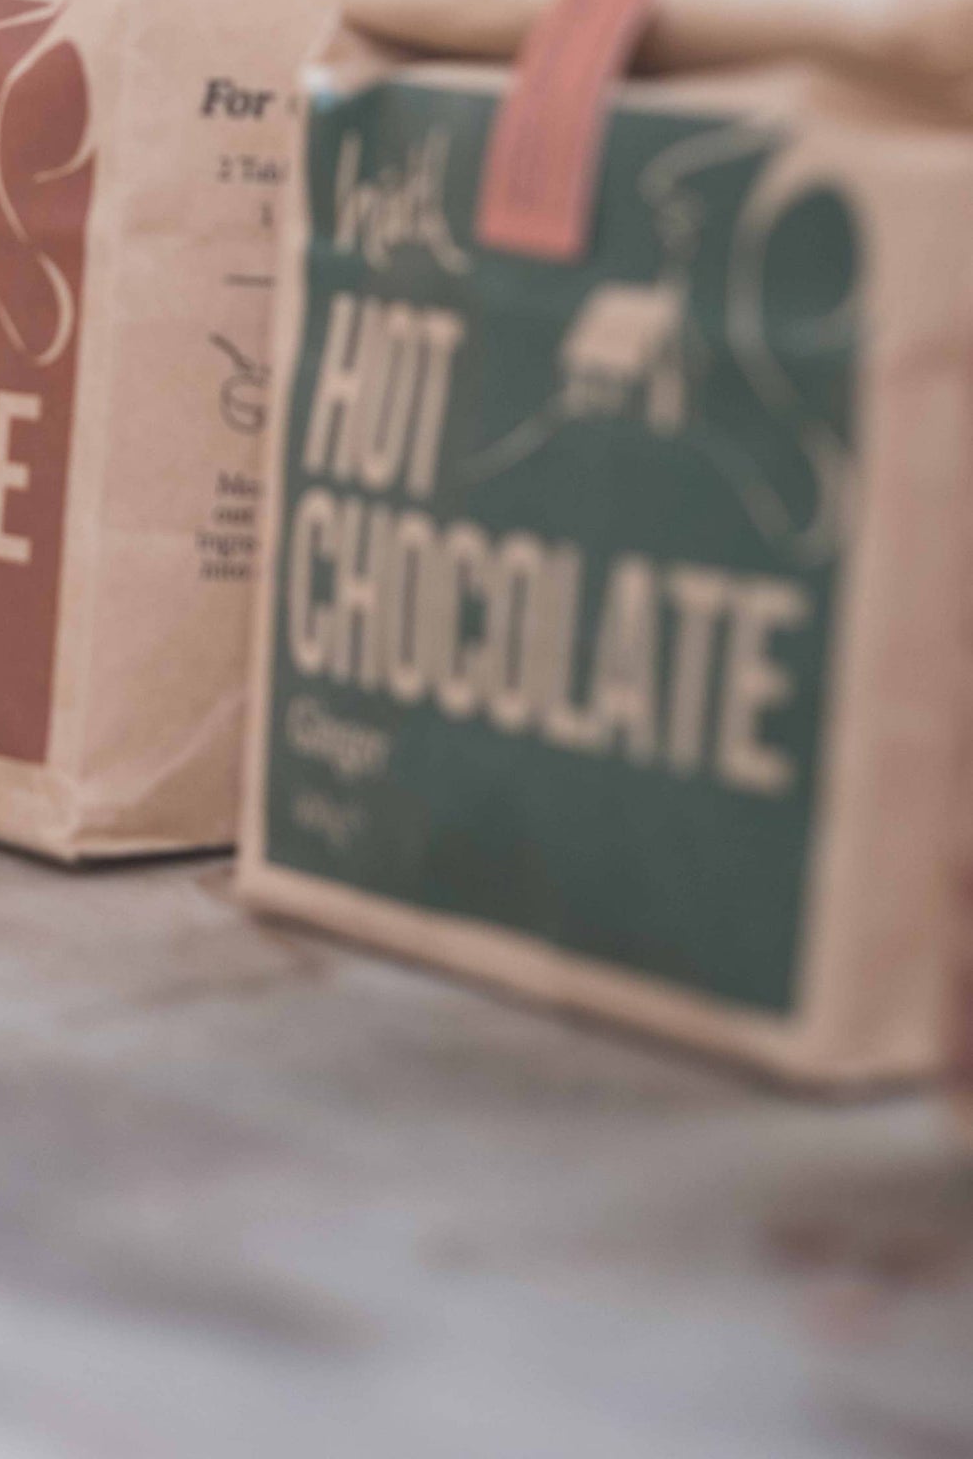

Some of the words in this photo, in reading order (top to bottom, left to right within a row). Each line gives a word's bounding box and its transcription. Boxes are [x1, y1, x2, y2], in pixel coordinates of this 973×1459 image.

[201, 77, 274, 120] For
[302, 290, 464, 495] HOT
[285, 485, 811, 797] CHOCOLATE
